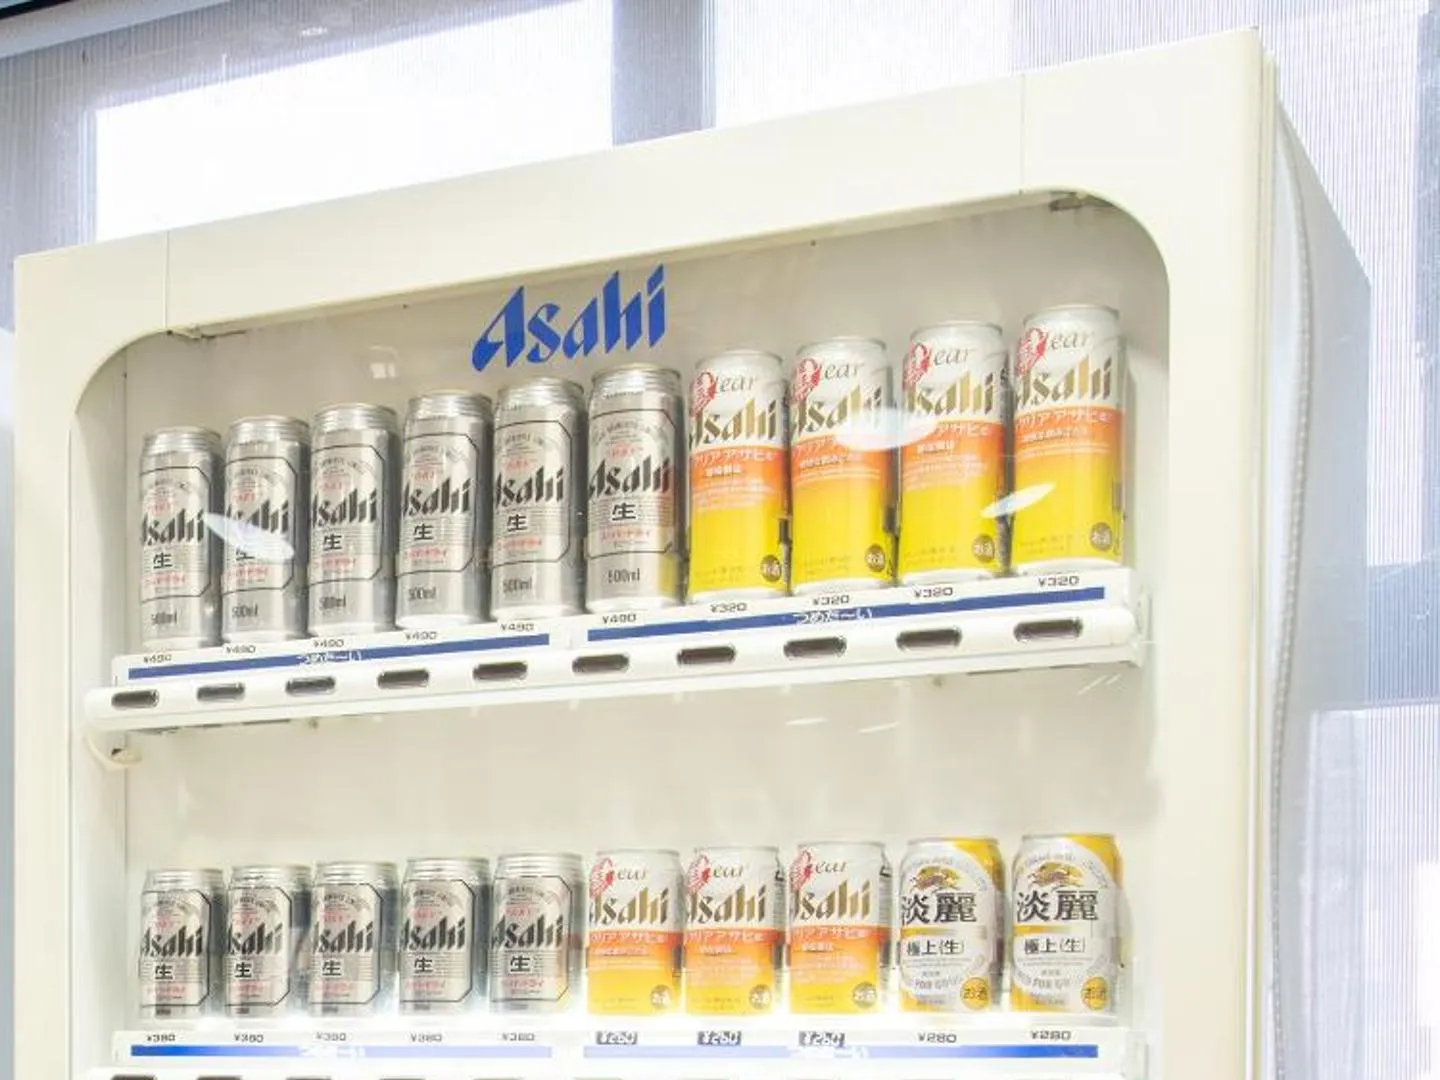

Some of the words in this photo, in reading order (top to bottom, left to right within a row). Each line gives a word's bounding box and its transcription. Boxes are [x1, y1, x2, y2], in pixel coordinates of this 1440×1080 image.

[472, 263, 665, 372] Asahi
[611, 503, 636, 521] 生
[507, 514, 527, 532] 生
[414, 524, 434, 540] 生
[323, 535, 342, 550] 生
[153, 553, 172, 569] 生
[902, 892, 978, 924] 淡麗
[1018, 890, 1100, 921] 淡麗
[155, 965, 174, 980] 生
[235, 962, 253, 978] 生
[322, 960, 342, 977] 生
[414, 957, 433, 974] 生
[510, 956, 531, 973] 生
